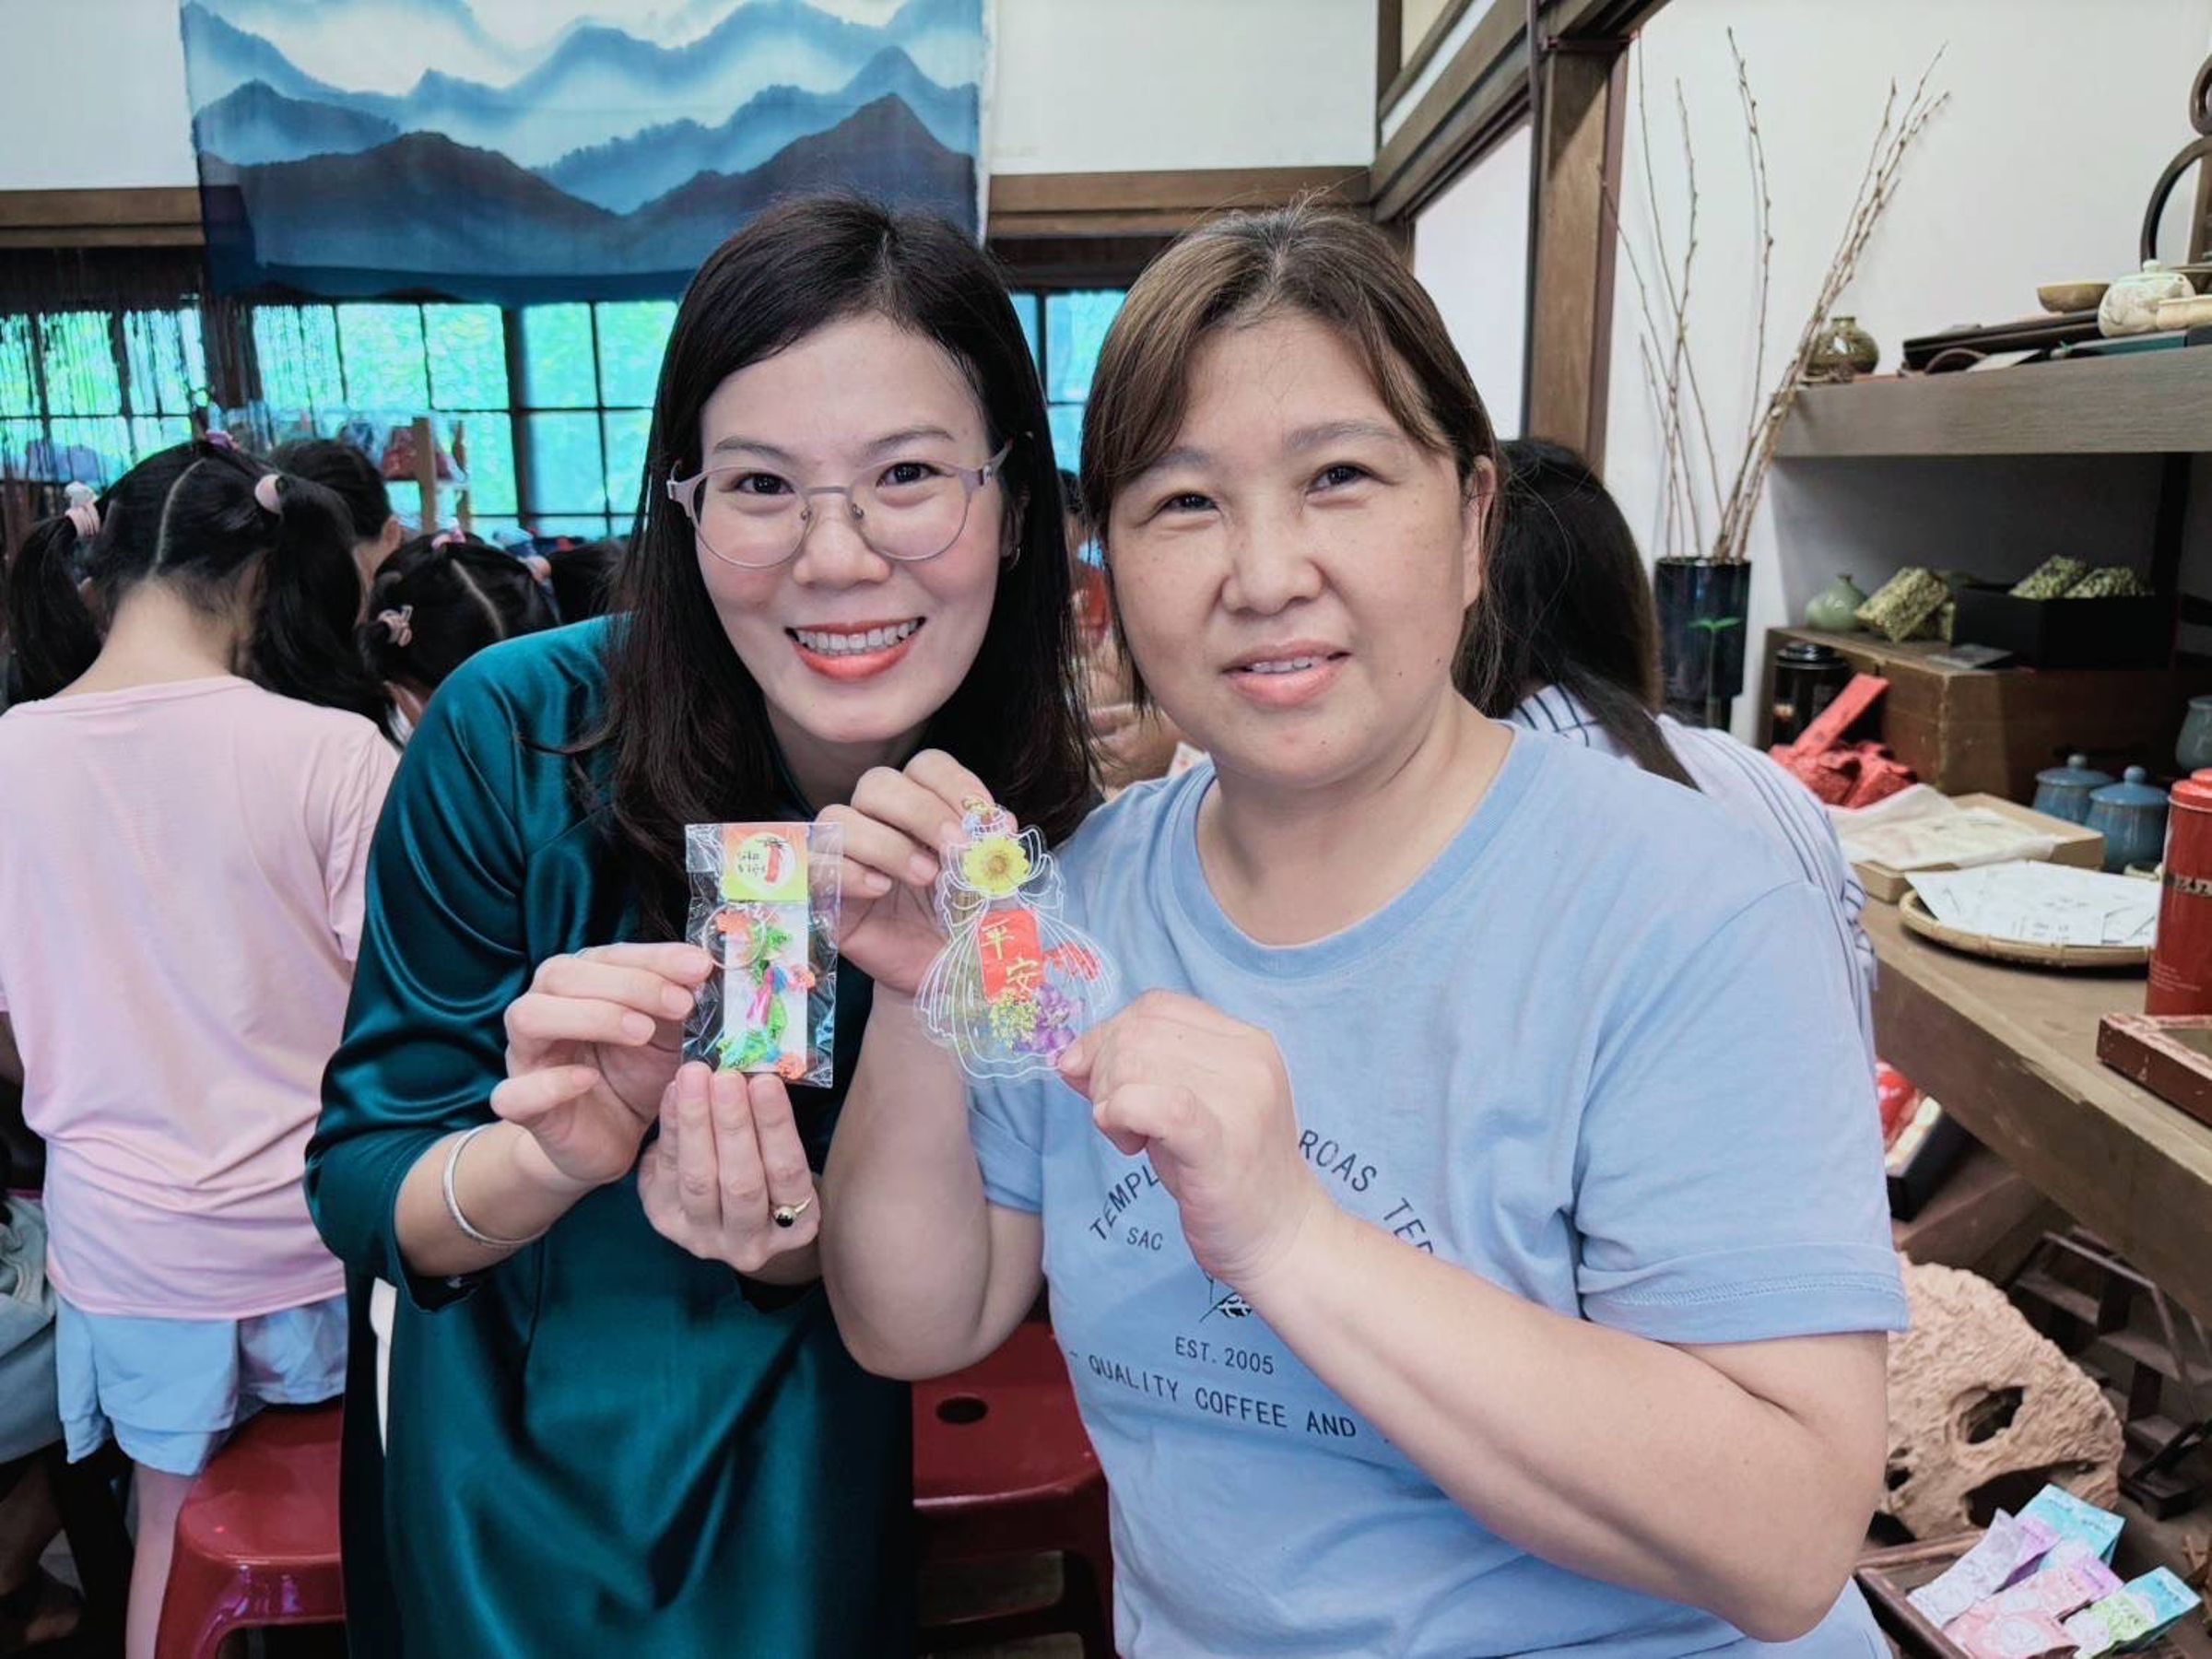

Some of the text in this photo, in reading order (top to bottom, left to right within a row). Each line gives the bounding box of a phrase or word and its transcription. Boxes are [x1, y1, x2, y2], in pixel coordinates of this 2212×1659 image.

[980, 918, 1040, 994] 平安
[1175, 1336, 1274, 1375] EST. 2005
[1088, 1354, 1357, 1438] QUALITY COFFEE AND
